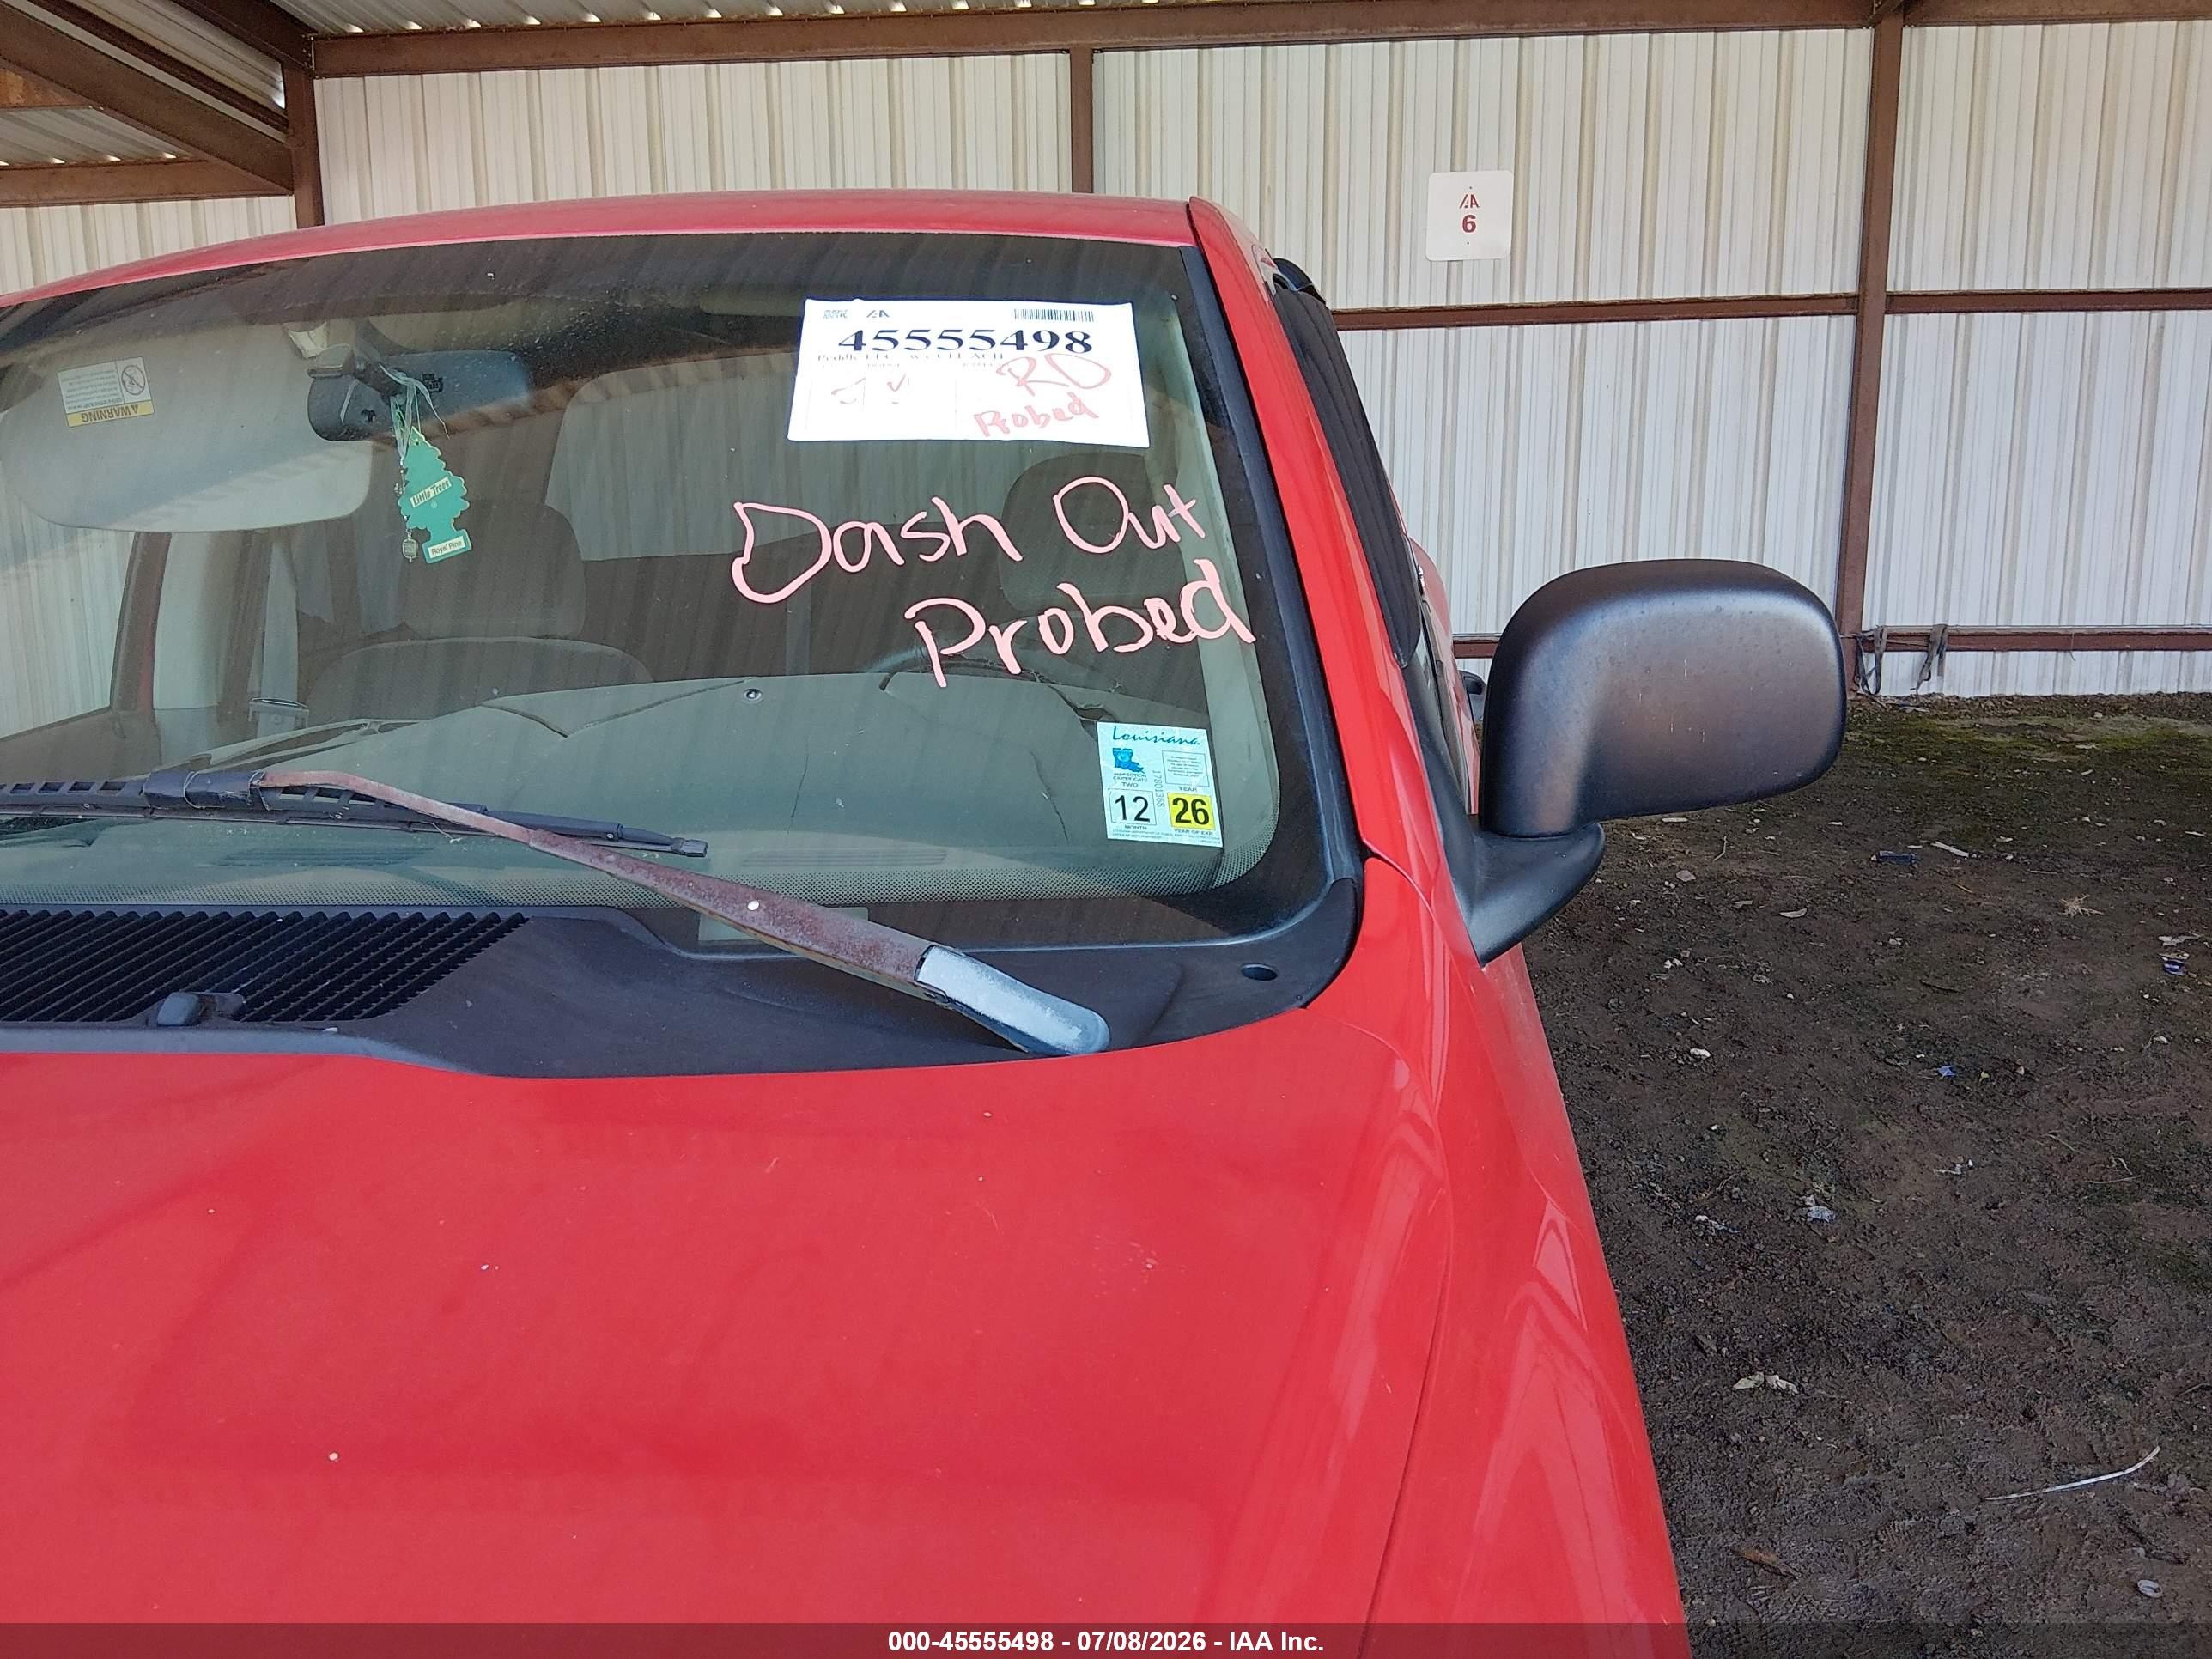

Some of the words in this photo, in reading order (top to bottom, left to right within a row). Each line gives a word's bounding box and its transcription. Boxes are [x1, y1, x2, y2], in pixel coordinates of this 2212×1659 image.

[1462, 214, 1477, 234] 6
[838, 329, 1093, 354] 45555498
[81, 405, 131, 423] WARNING
[412, 490, 431, 507] Little
[431, 480, 450, 495] Trees
[431, 544, 448, 556] Royal
[447, 540, 463, 551] Pine
[731, 495, 1025, 605] Dash
[1052, 475, 1206, 555] Out
[903, 558, 1257, 689] Probed
[1114, 794, 1151, 823] 12
[1171, 797, 1210, 825] 26
